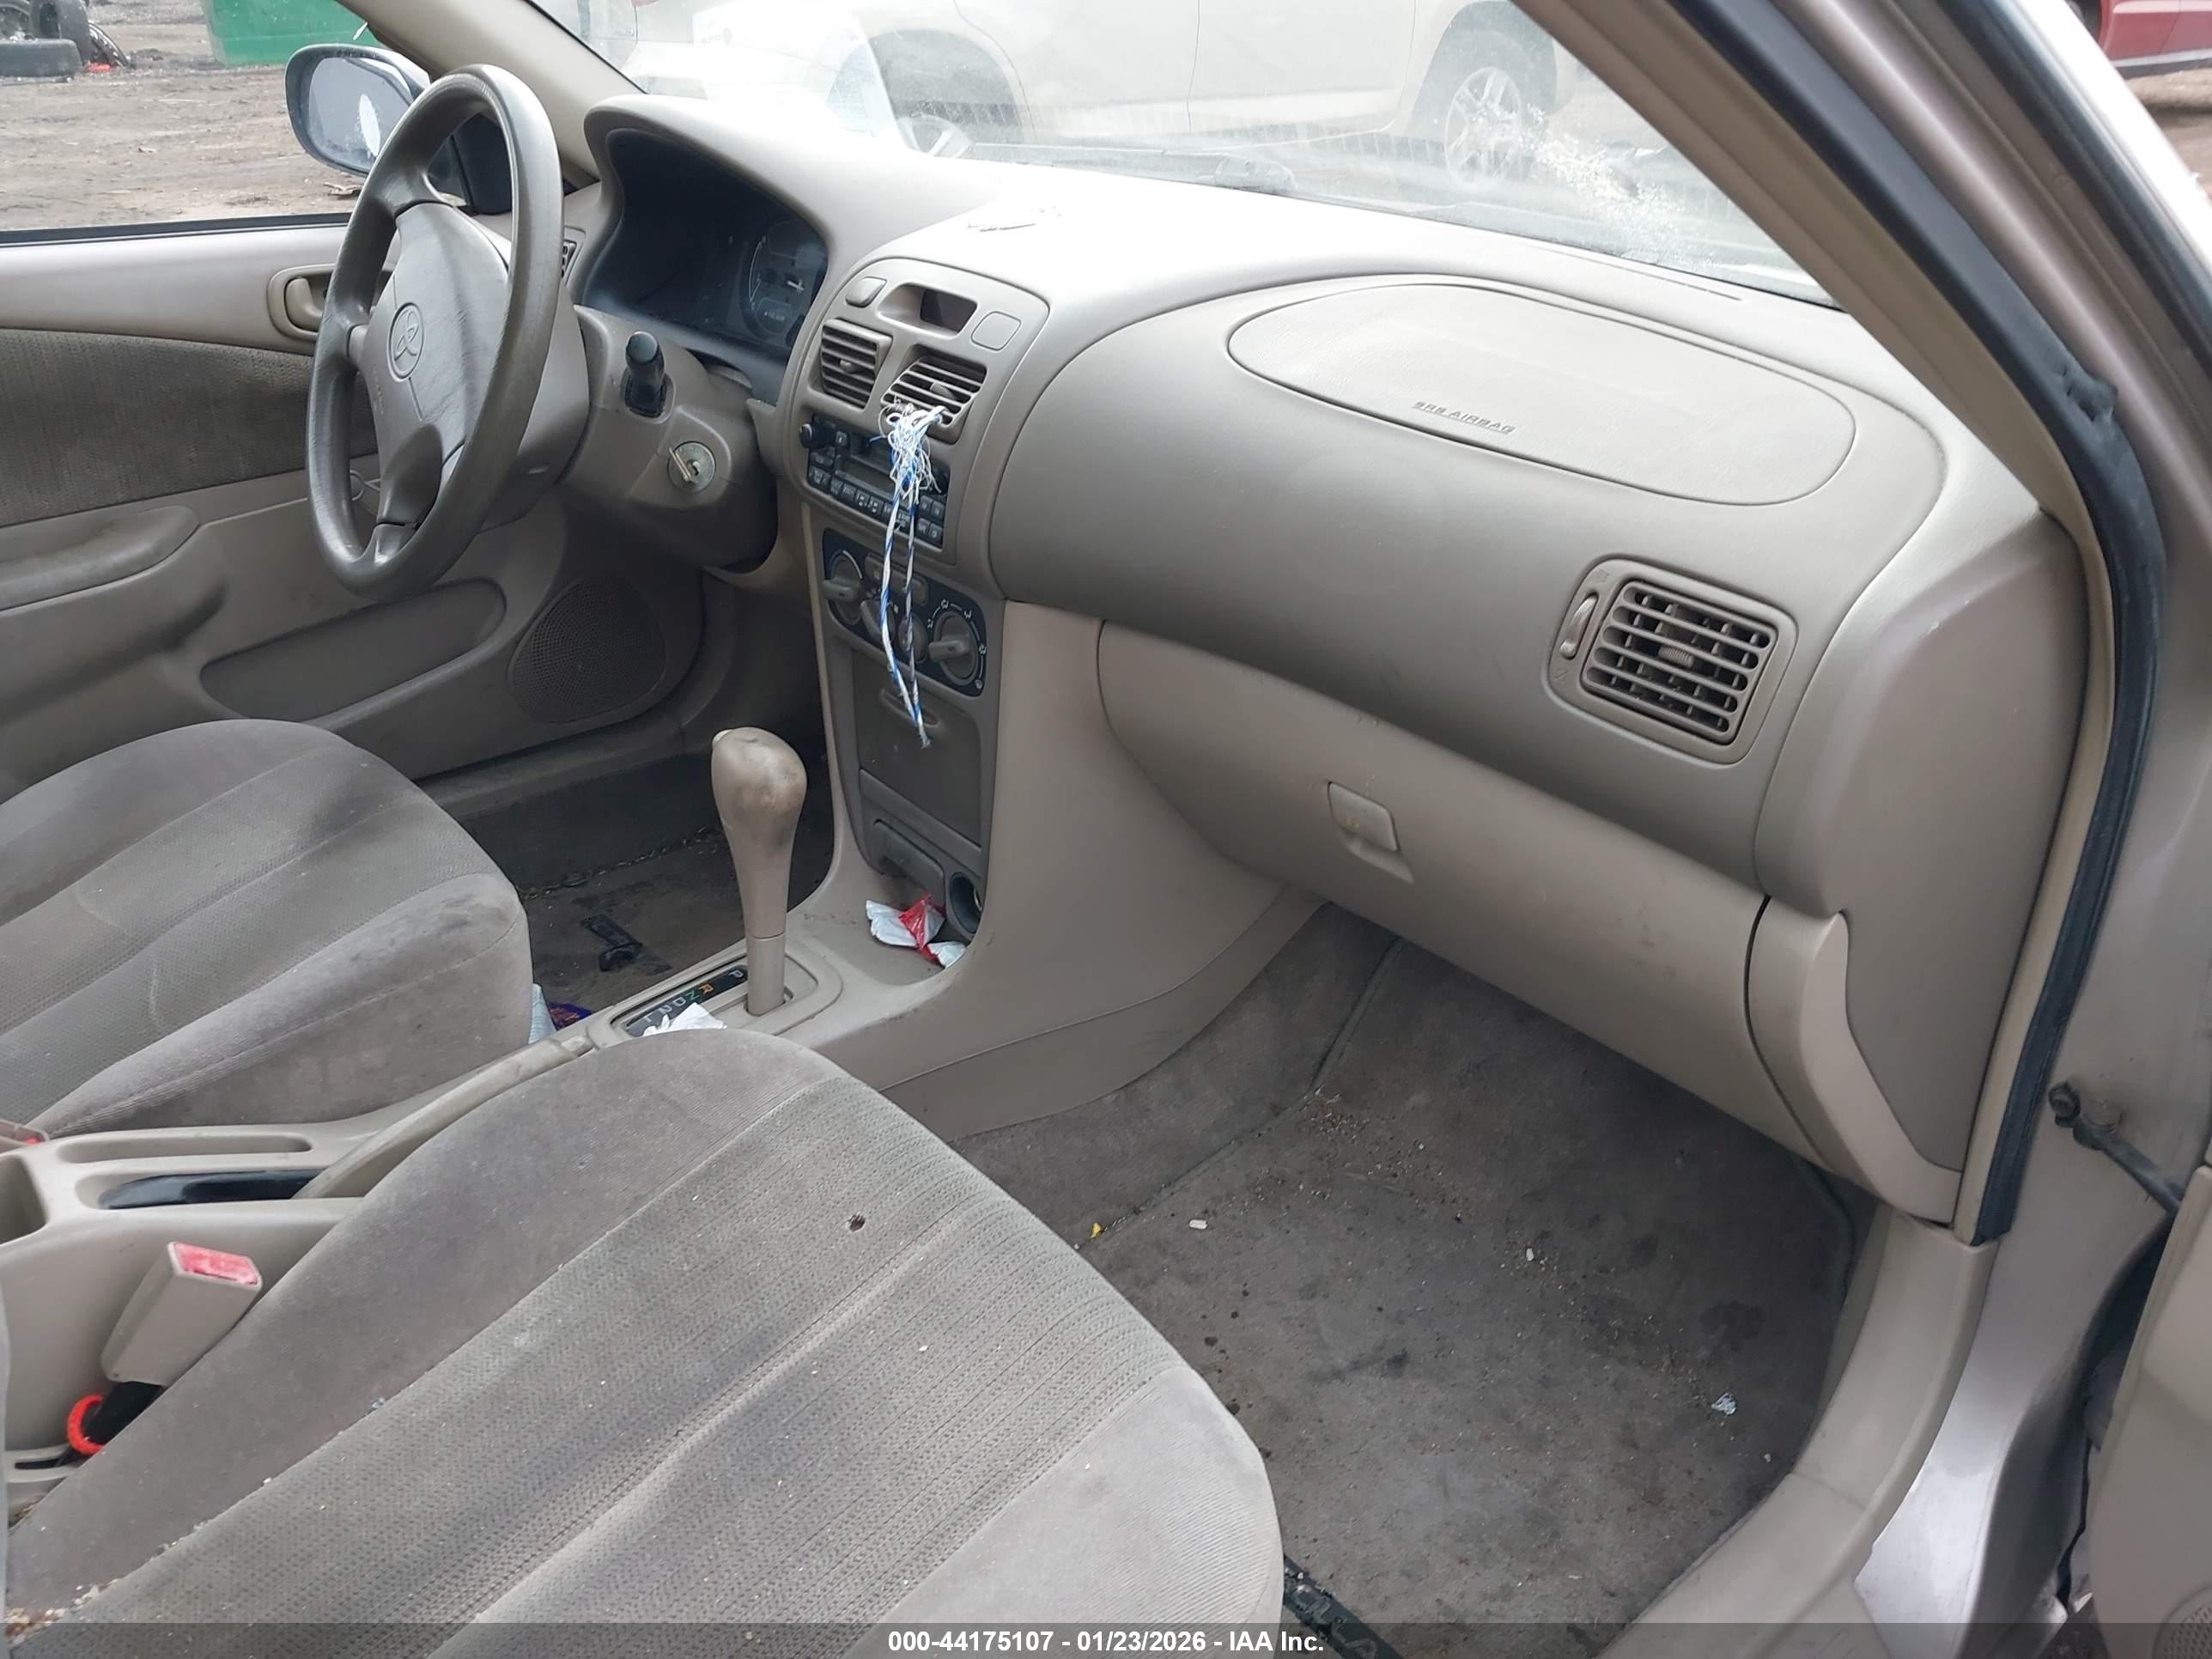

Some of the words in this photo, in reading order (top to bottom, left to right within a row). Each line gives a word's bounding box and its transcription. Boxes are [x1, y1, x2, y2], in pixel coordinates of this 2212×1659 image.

[1413, 401, 1447, 415] SRS
[1449, 410, 1516, 434] AIRBAG
[728, 969, 744, 978] P
[699, 983, 714, 994] R
[673, 997, 686, 1007] D
